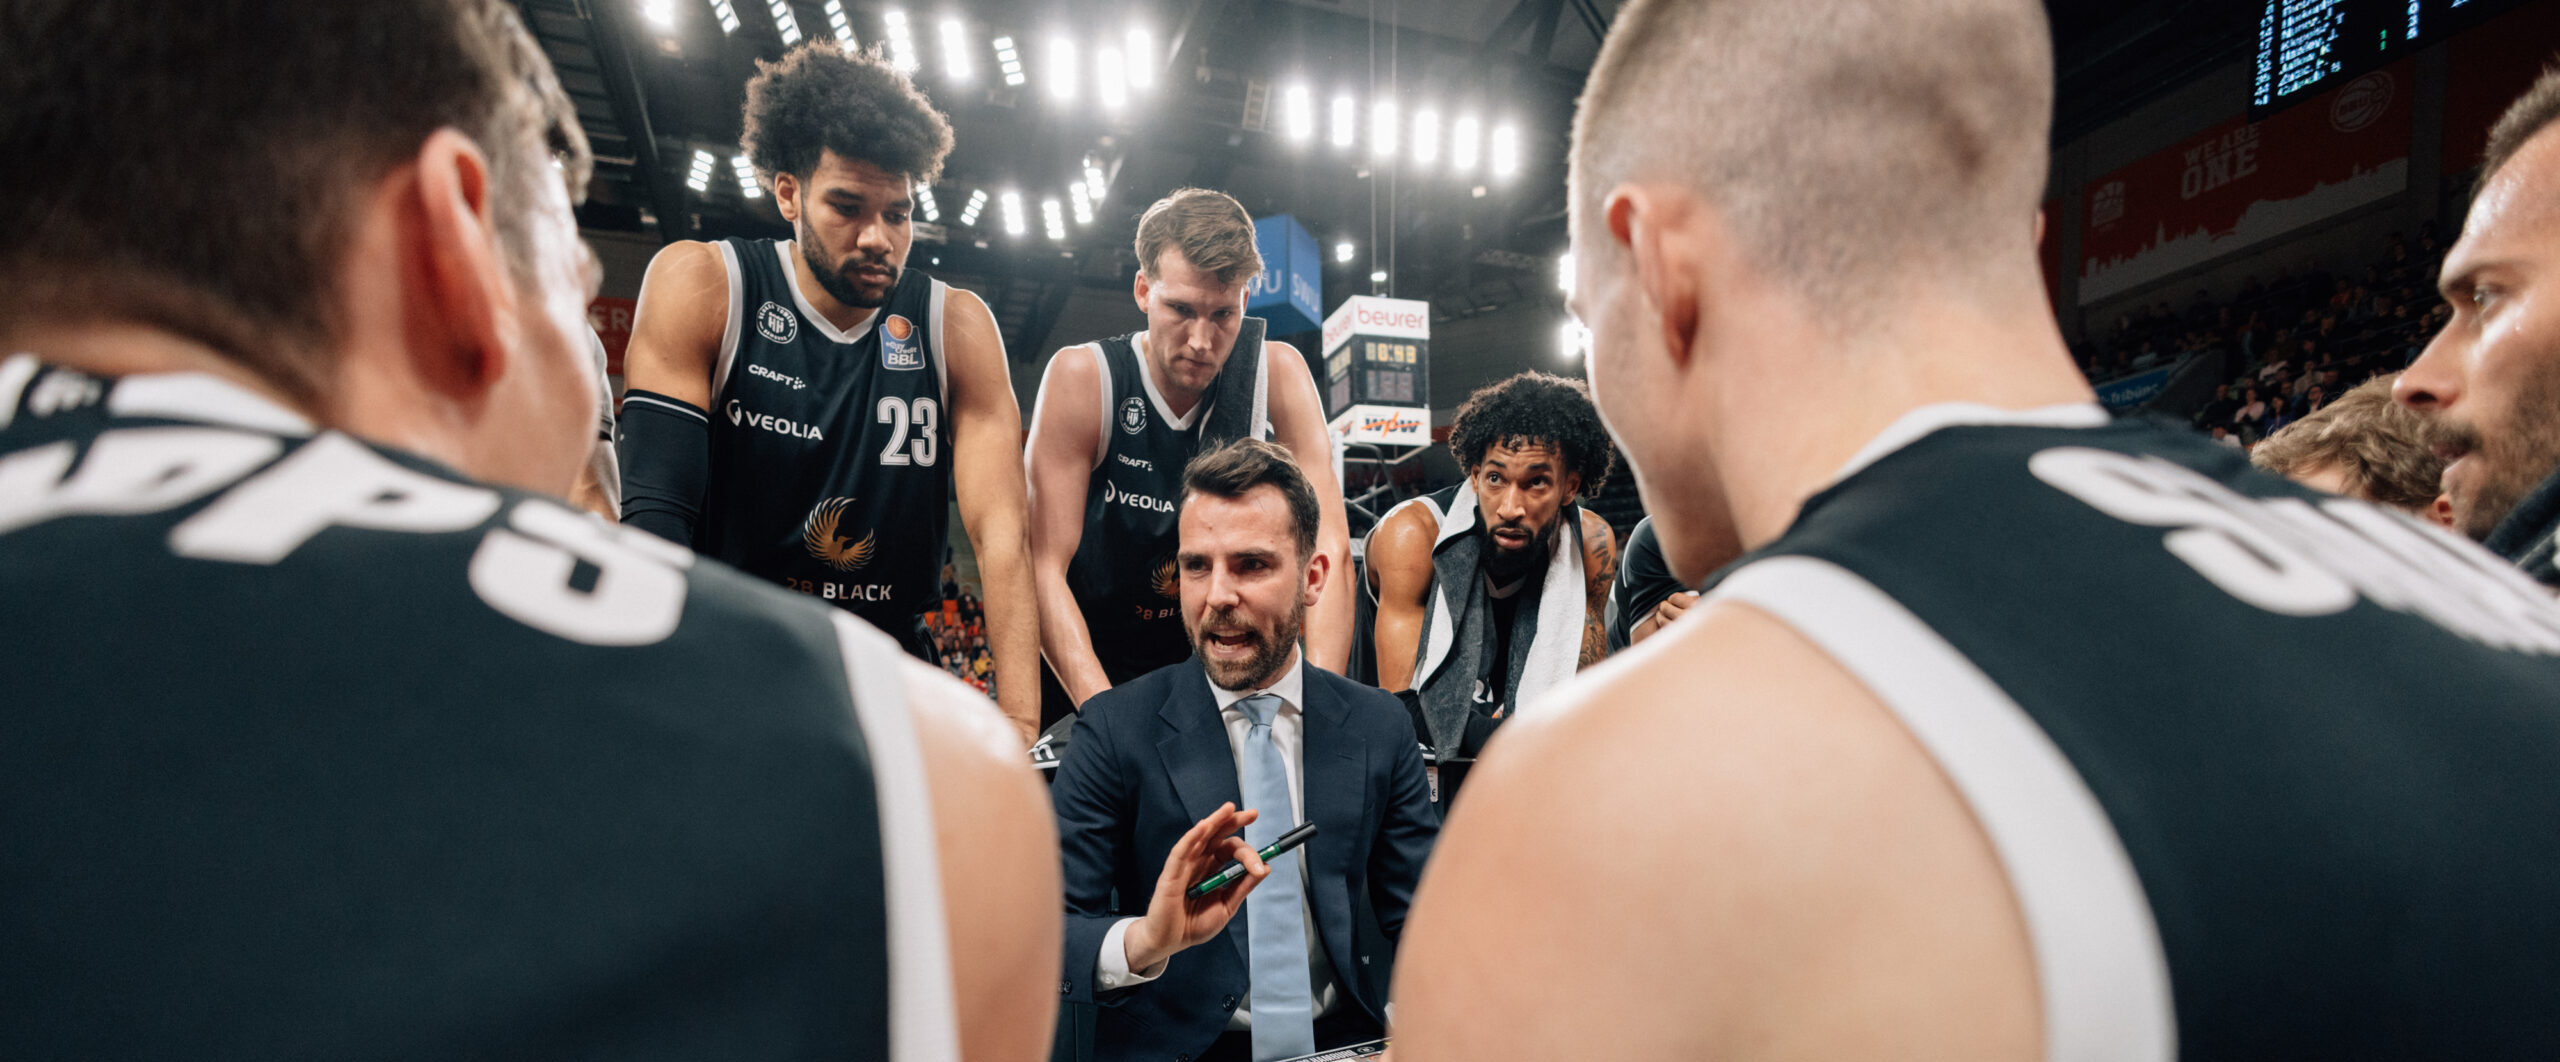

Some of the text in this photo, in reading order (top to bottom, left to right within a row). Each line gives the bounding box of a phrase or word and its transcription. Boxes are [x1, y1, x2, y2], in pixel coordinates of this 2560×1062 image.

[2180, 137, 2260, 201] ONE
[1357, 303, 1425, 329] beurer
[887, 353, 919, 366] BBL
[748, 364, 795, 387] CRAFT
[745, 410, 825, 442] VEOLIA
[877, 396, 938, 468] 23
[1117, 453, 1149, 469] CRAFT
[1118, 490, 1175, 513] VEOLIA
[822, 582, 893, 602] BLACK
